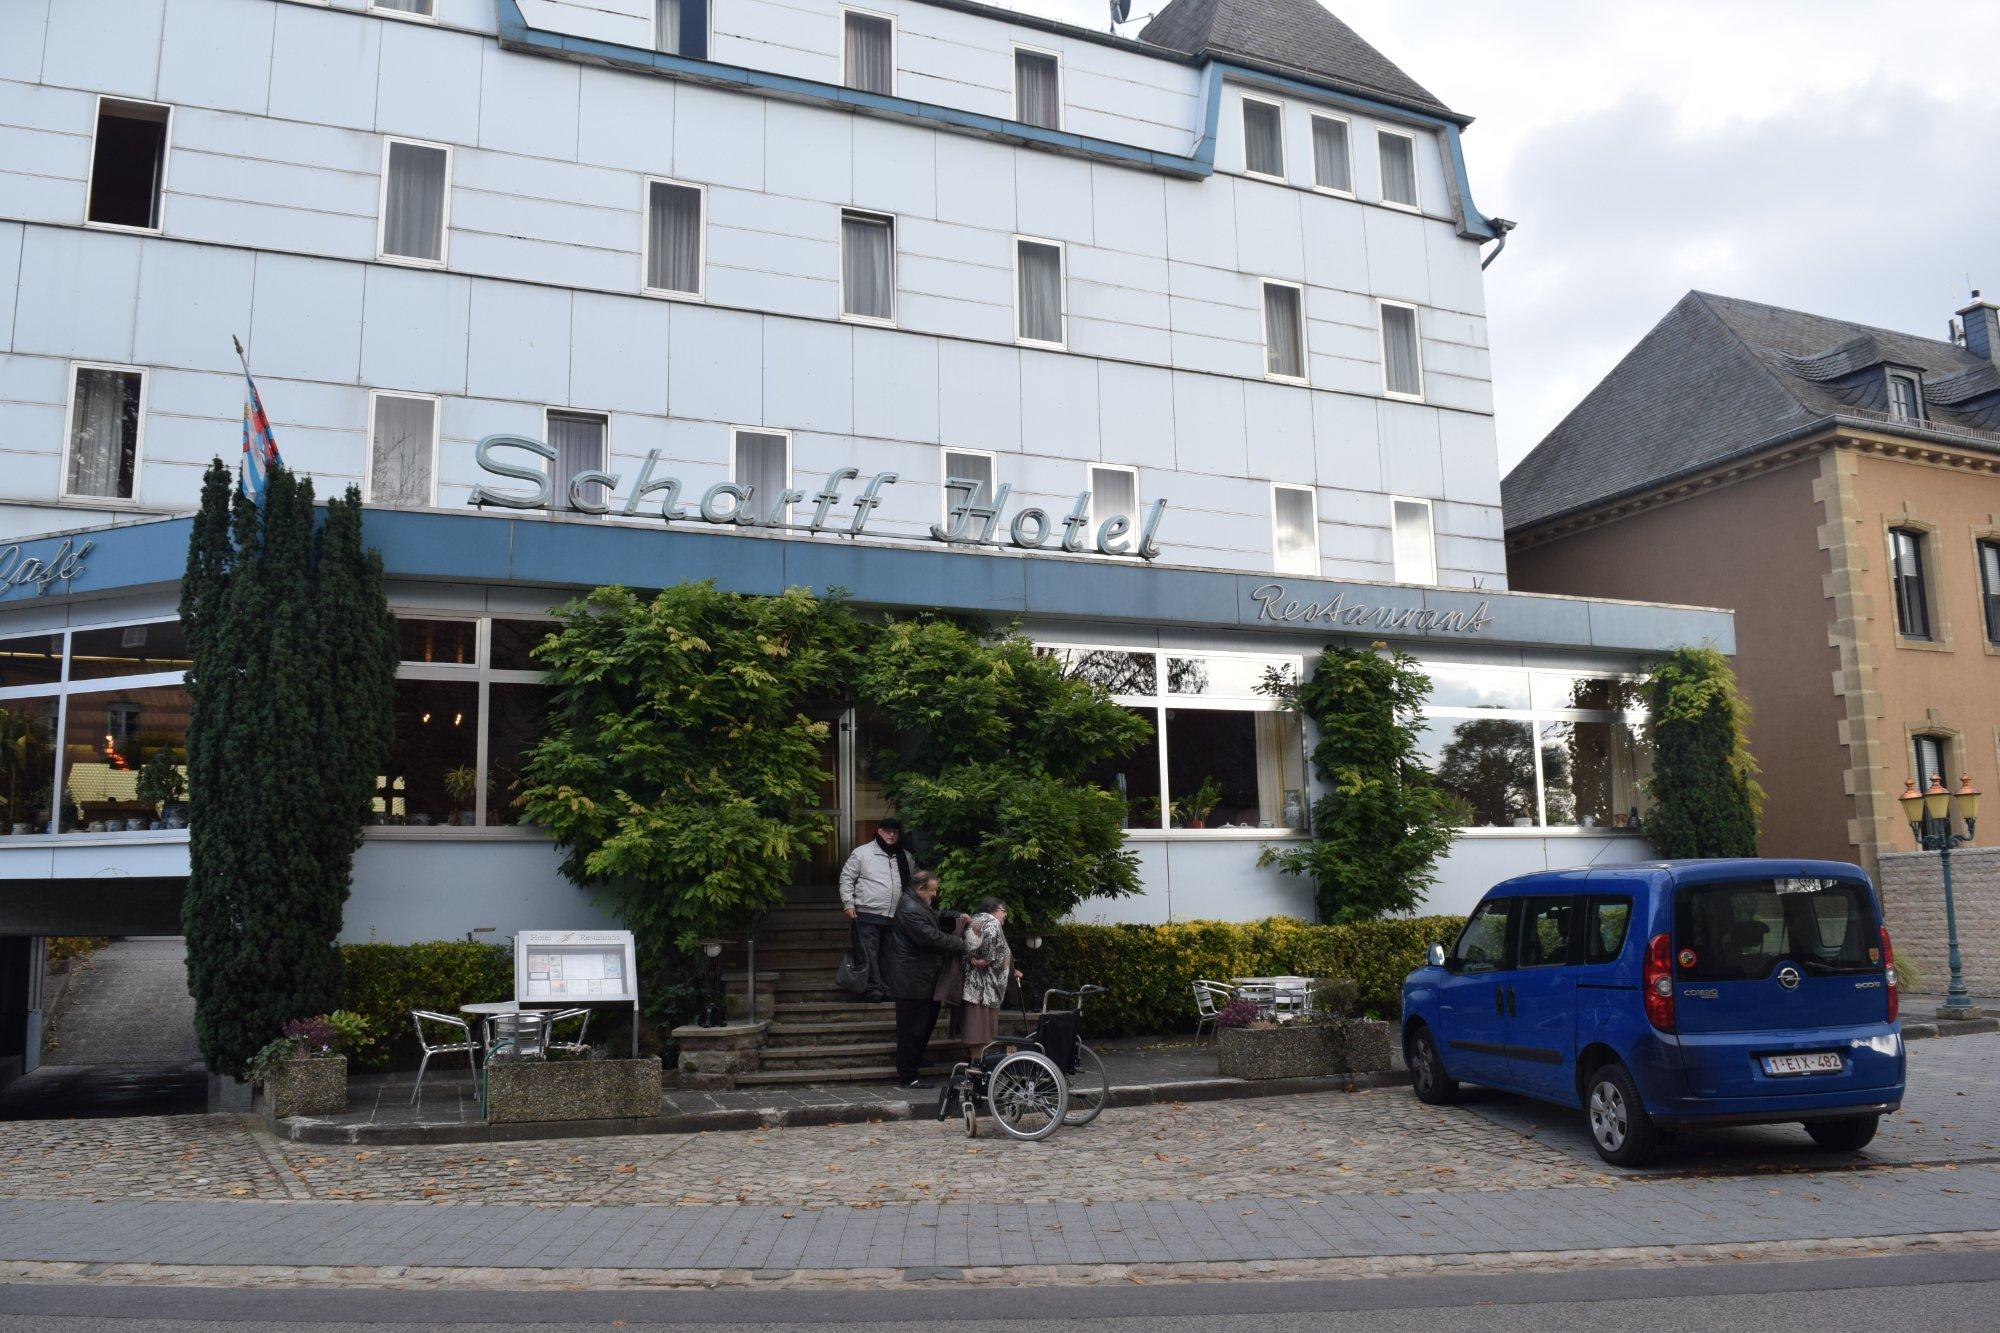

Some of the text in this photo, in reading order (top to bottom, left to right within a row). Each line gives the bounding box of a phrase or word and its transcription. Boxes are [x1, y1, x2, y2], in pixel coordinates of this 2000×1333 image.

[469, 433, 1168, 560] Scharff Hotel
[1251, 583, 1496, 632] Restaurant
